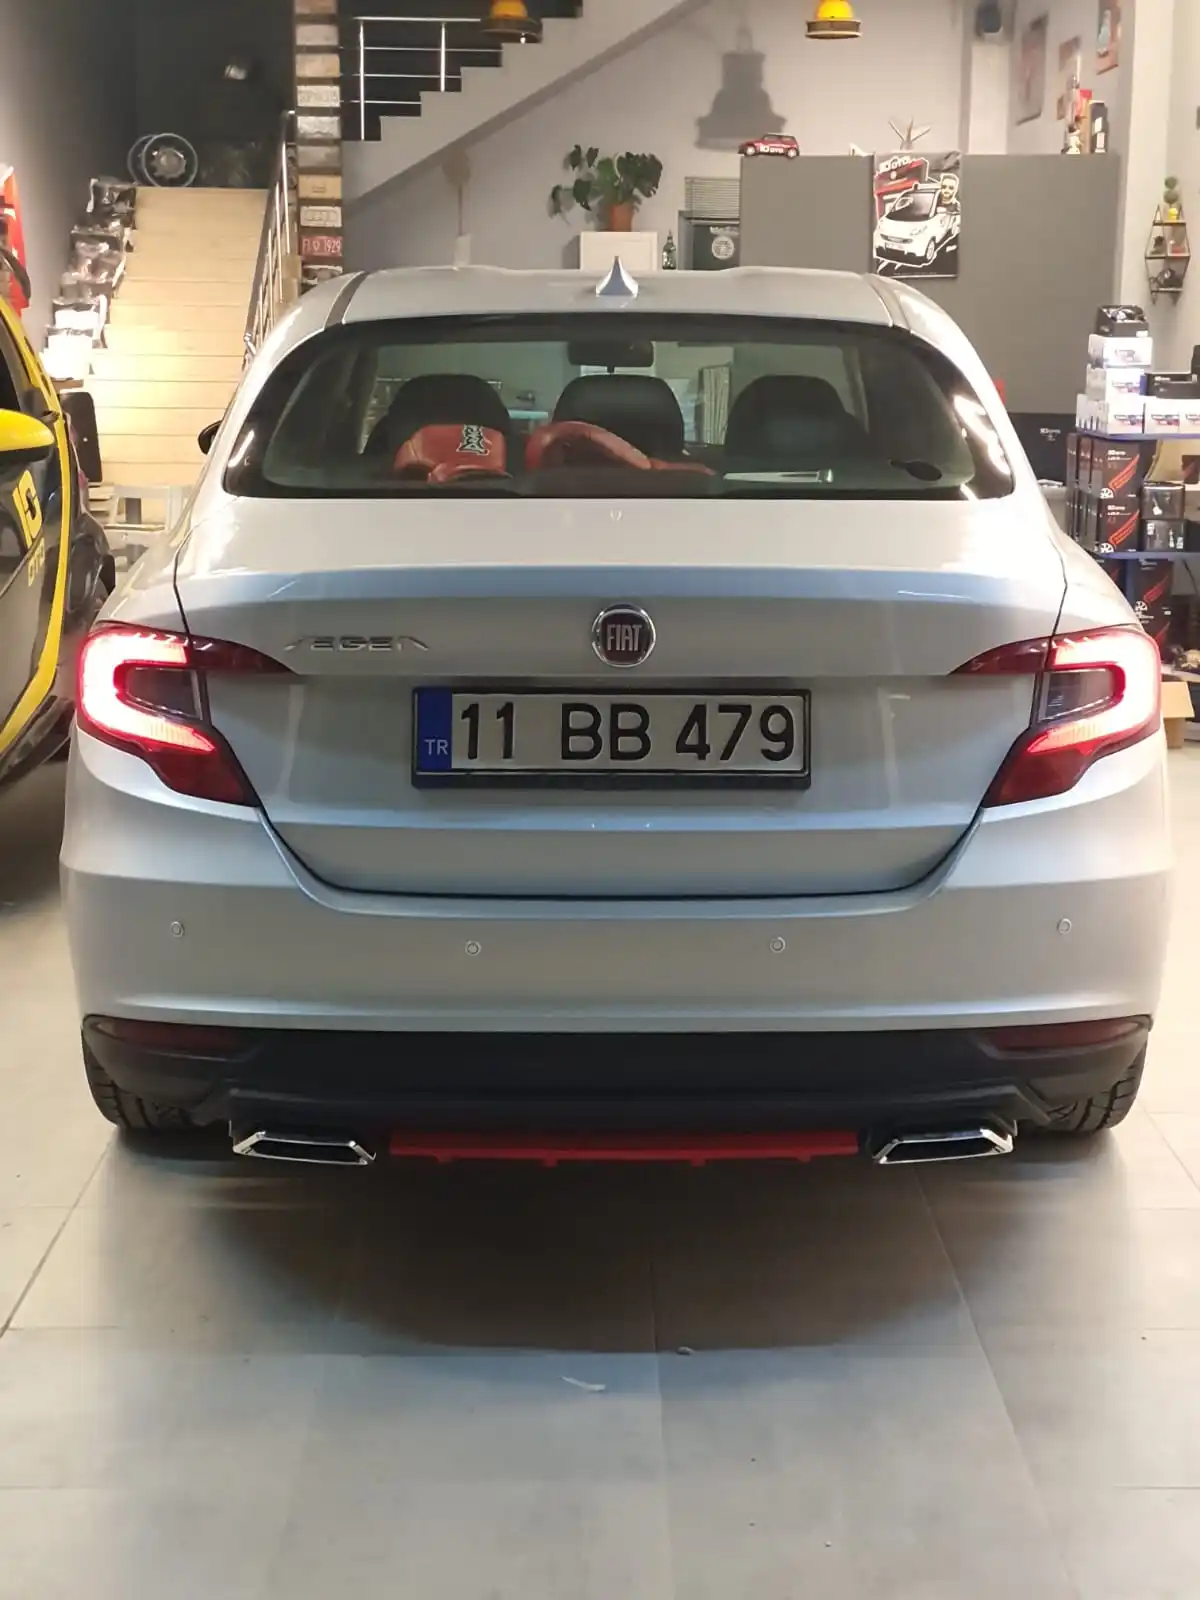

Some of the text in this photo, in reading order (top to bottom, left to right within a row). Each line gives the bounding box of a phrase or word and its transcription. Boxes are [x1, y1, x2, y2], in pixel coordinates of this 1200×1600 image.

[607, 624, 642, 651] FIAT
[461, 702, 795, 763] 11 BB 479
[425, 739, 448, 756] TR
